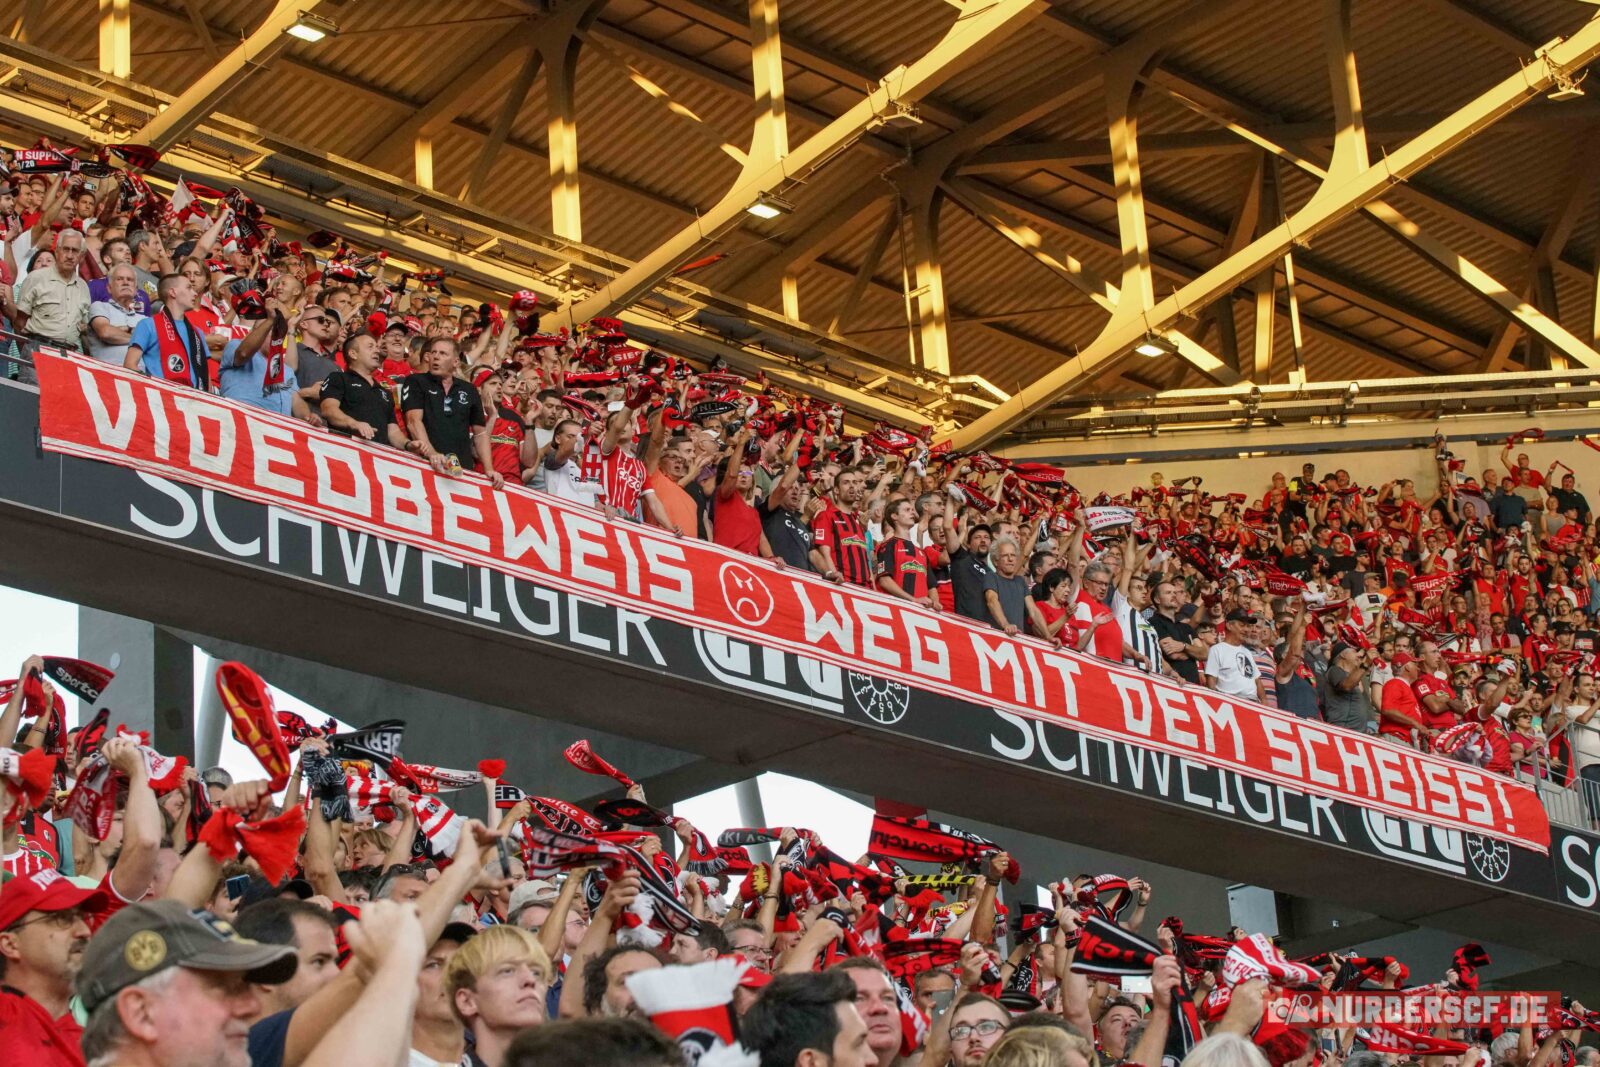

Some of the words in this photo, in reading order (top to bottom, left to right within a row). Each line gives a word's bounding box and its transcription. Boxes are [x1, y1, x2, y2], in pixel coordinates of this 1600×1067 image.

[791, 580, 951, 682] WEG
[968, 631, 1082, 718] MIT
[1108, 671, 1247, 762] DEM
[1259, 714, 1516, 834] SCHEISS!
[1562, 834, 1600, 908] S
